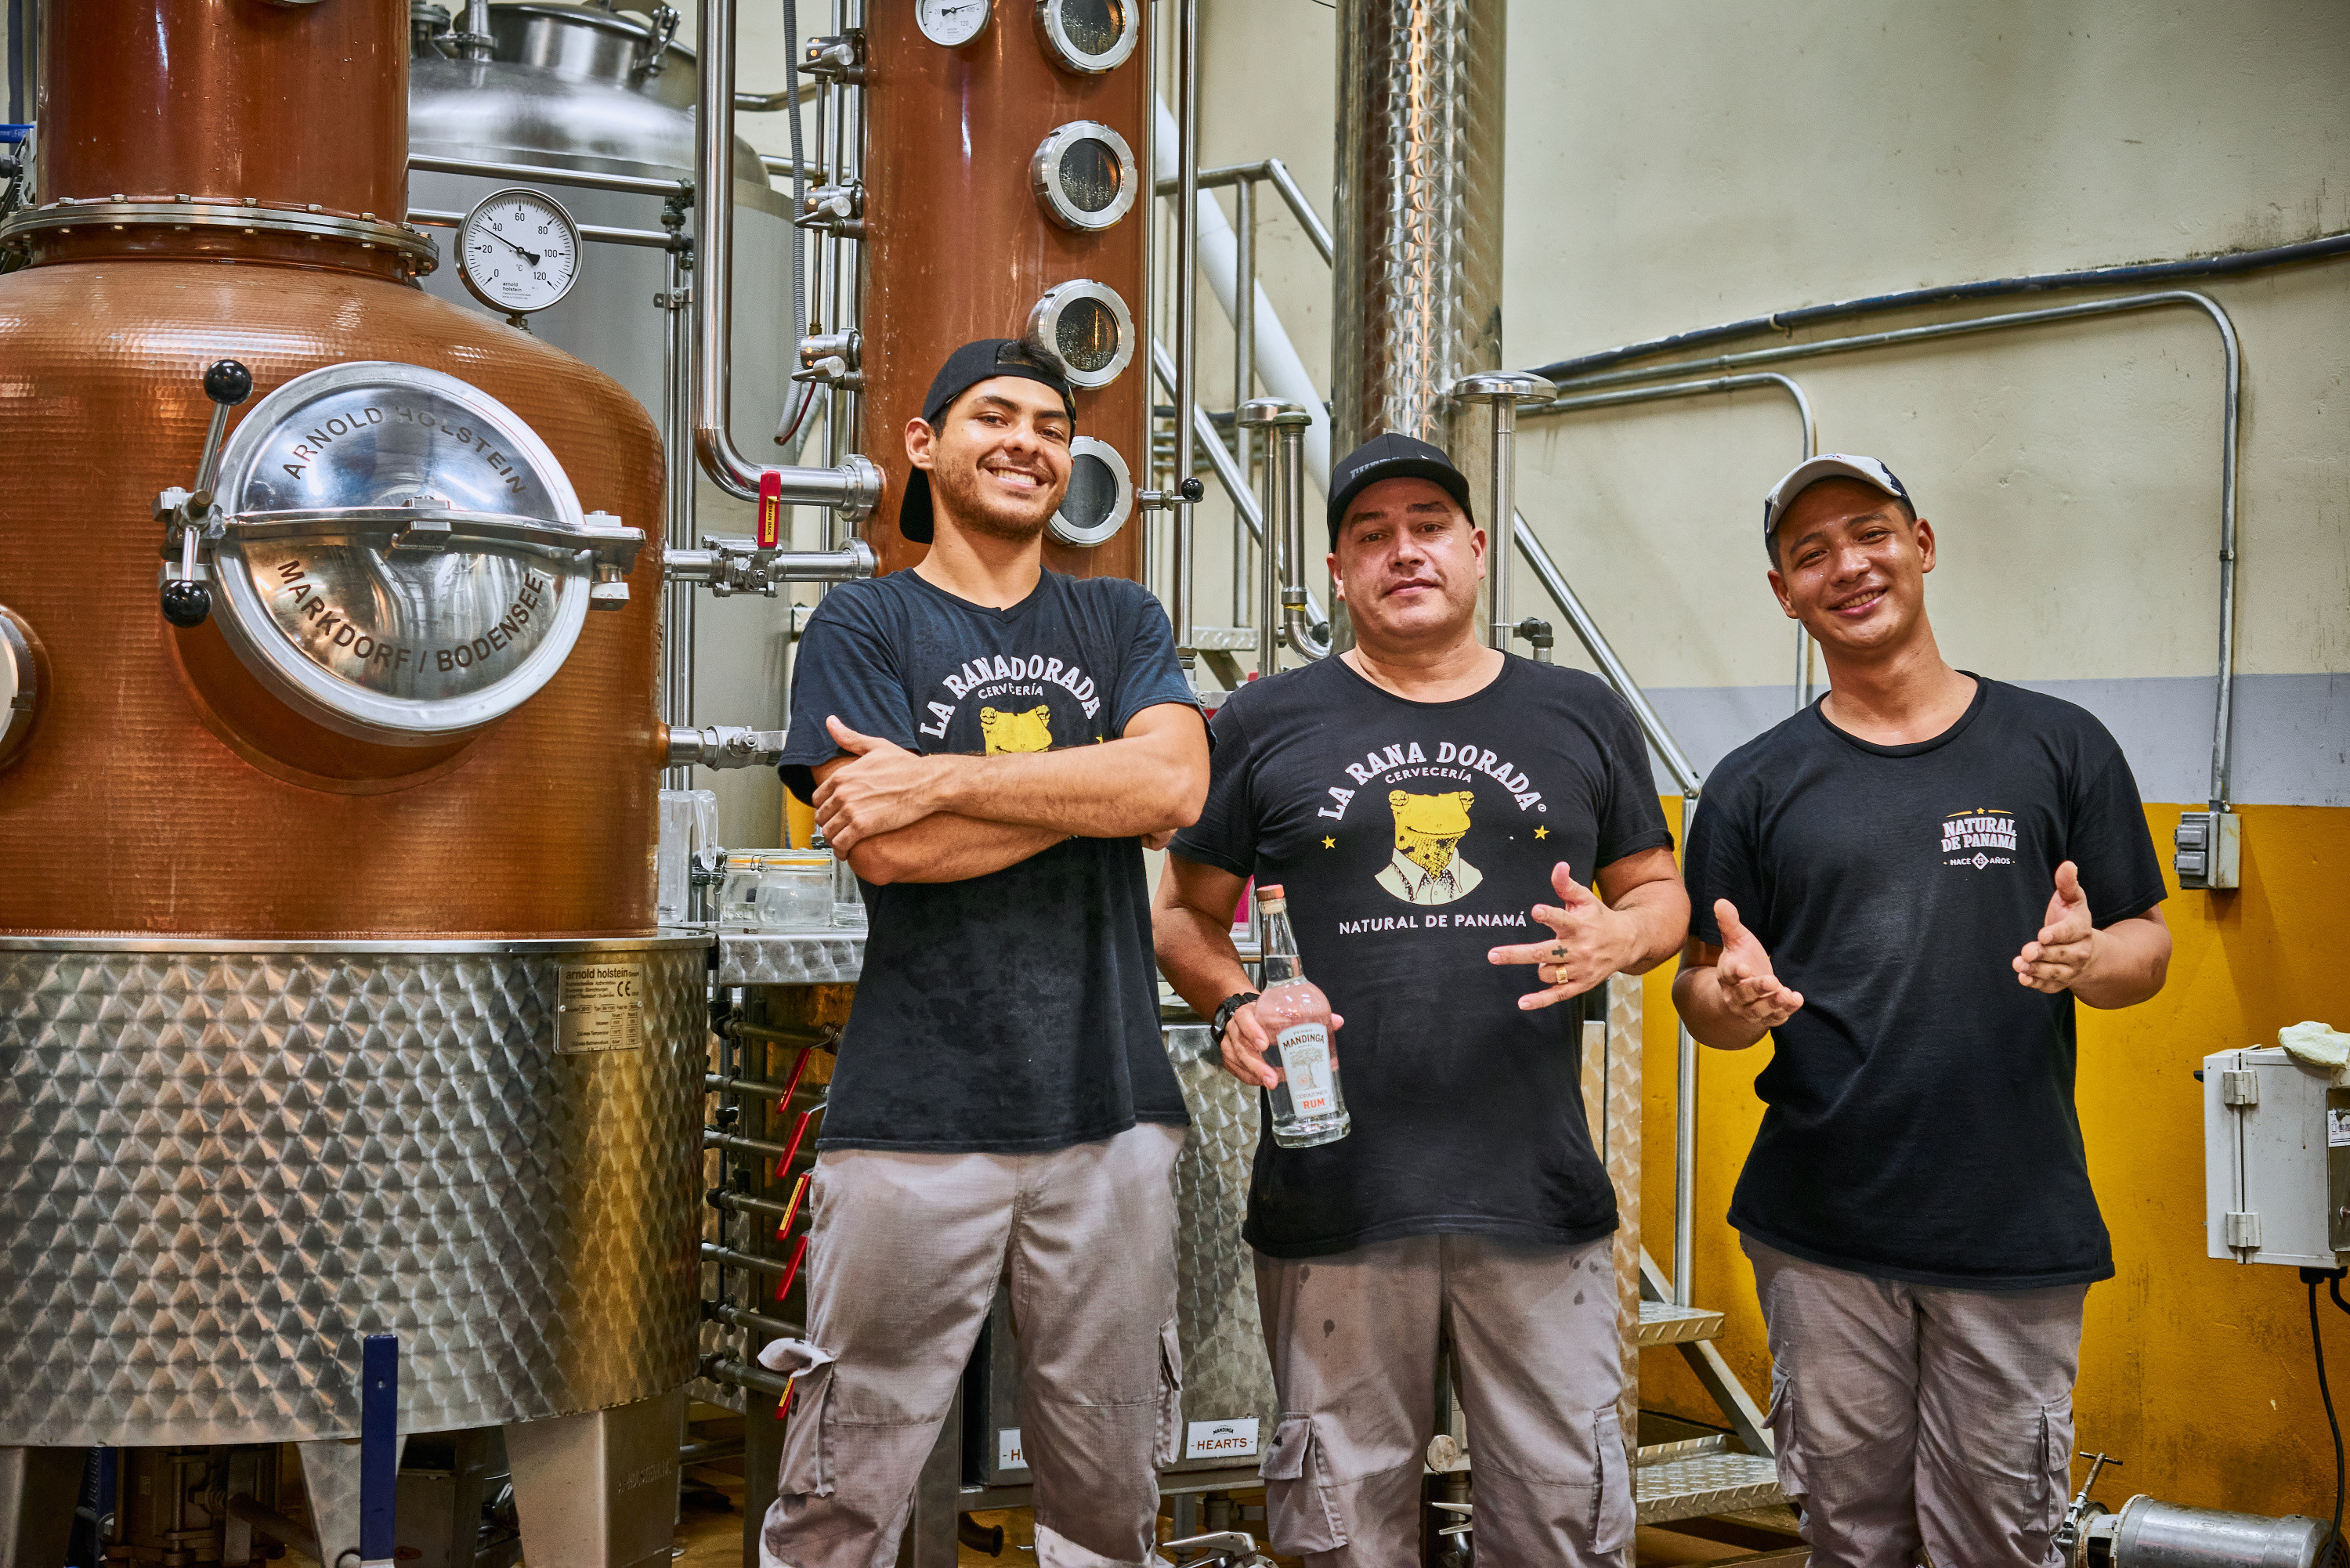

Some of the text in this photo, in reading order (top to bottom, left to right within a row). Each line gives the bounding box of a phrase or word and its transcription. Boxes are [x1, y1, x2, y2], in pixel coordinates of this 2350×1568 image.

[515, 213, 525, 222] 60
[493, 223, 503, 232] 40
[538, 226, 548, 235] 80
[483, 244, 493, 254] 20
[544, 249, 558, 258] 100
[494, 269, 499, 277] 0
[533, 272, 547, 280] 120
[283, 406, 527, 494] ARNOLD HOLSTEIN
[277, 560, 411, 670] MARKDORF
[436, 573, 544, 672] BODENSEE
[920, 700, 956, 739] LA
[1318, 742, 1542, 821] LA RANA DORADA
[1384, 767, 1472, 784] CERVECERÍA
[1942, 817, 2017, 837] NATURAL
[1941, 836, 1961, 853] DE
[1989, 856, 2011, 865] AÑOS
[1339, 911, 1527, 935] NATURAL DE PANAMÁ
[566, 968, 595, 979] arnold
[597, 967, 628, 978] holstein
[1282, 1034, 1325, 1050] MANDINGA
[1296, 1089, 1329, 1099] CORAZONES
[1303, 1098, 1325, 1109] RUM
[1197, 1437, 1248, 1451] HEARTS
